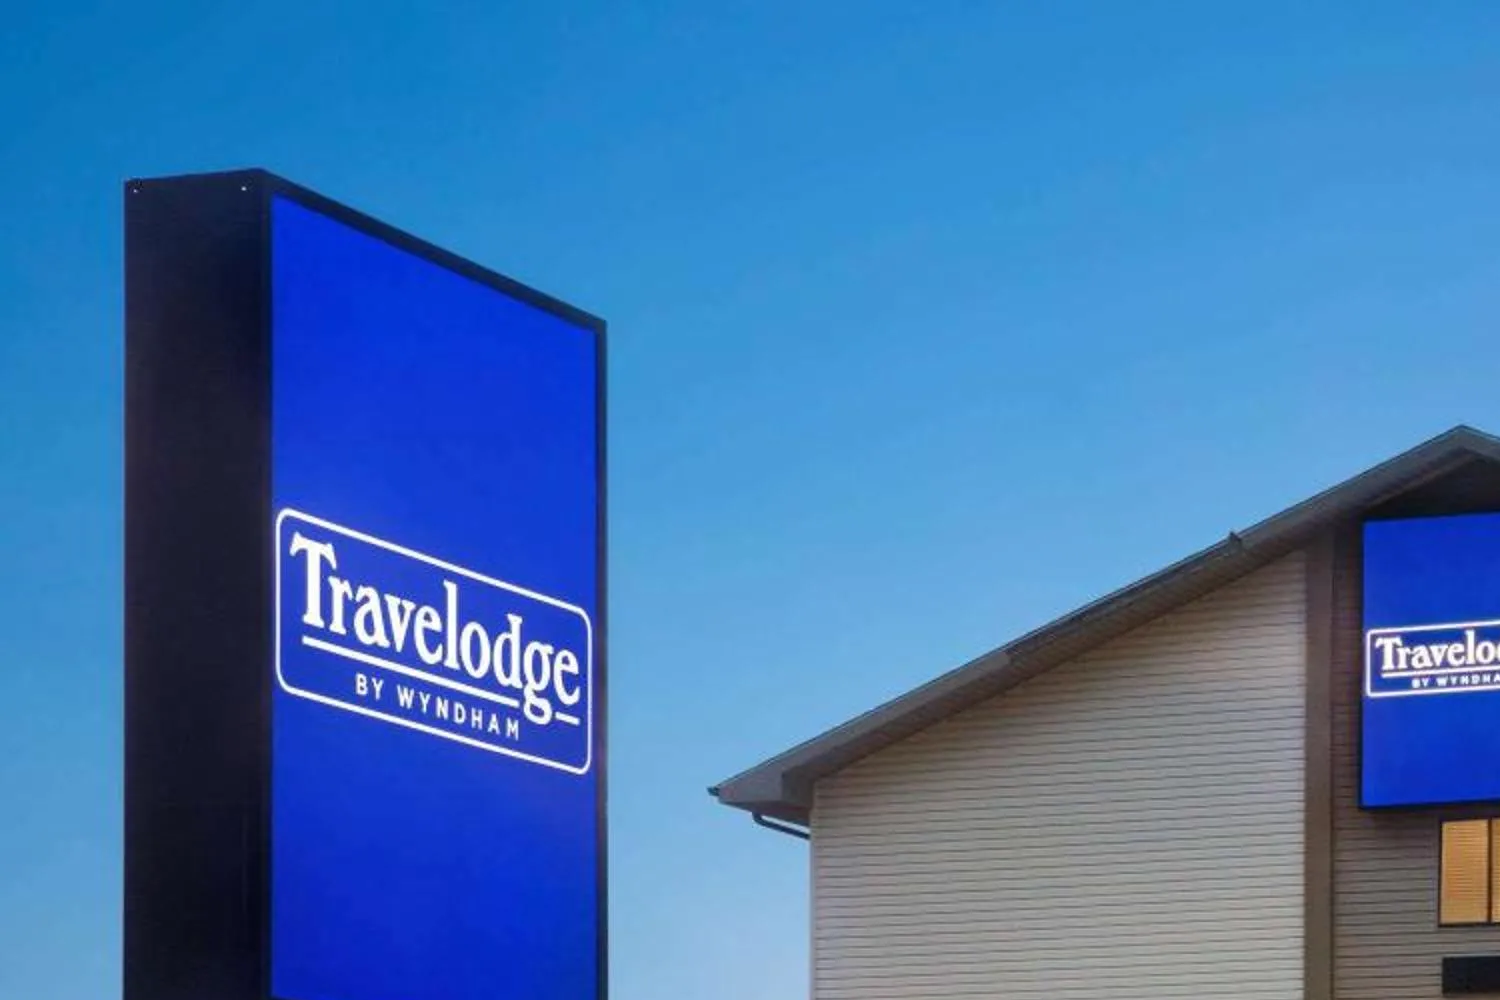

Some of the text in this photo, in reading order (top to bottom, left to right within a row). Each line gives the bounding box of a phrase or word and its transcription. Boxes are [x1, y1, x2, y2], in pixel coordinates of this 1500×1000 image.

[290, 531, 580, 725] Travelodge
[355, 673, 519, 740] BY WYNDHAM
[1412, 677, 1430, 689] BY
